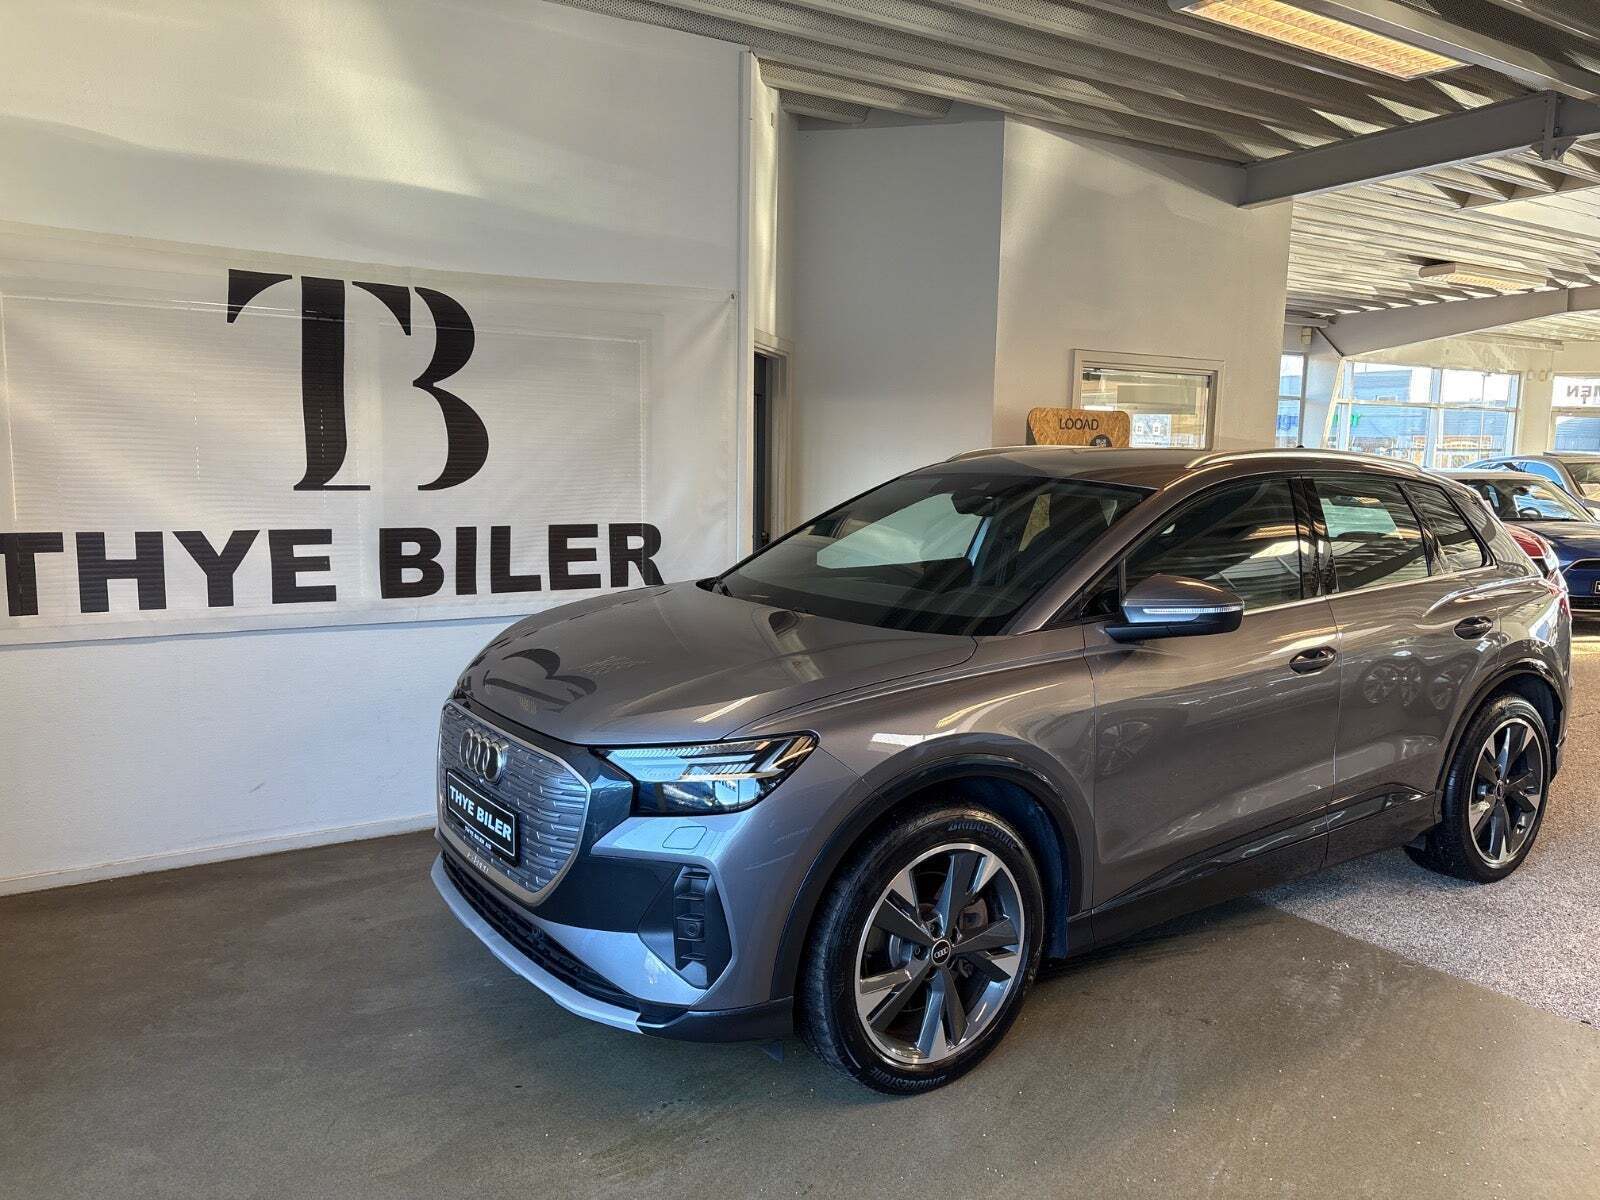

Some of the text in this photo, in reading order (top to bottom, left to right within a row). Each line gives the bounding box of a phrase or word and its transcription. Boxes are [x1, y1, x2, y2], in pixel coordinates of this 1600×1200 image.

[1059, 417, 1099, 430] LOOAD
[0, 523, 666, 616] THYE BILER
[449, 784, 475, 816] THYE
[476, 806, 512, 842] BILER
